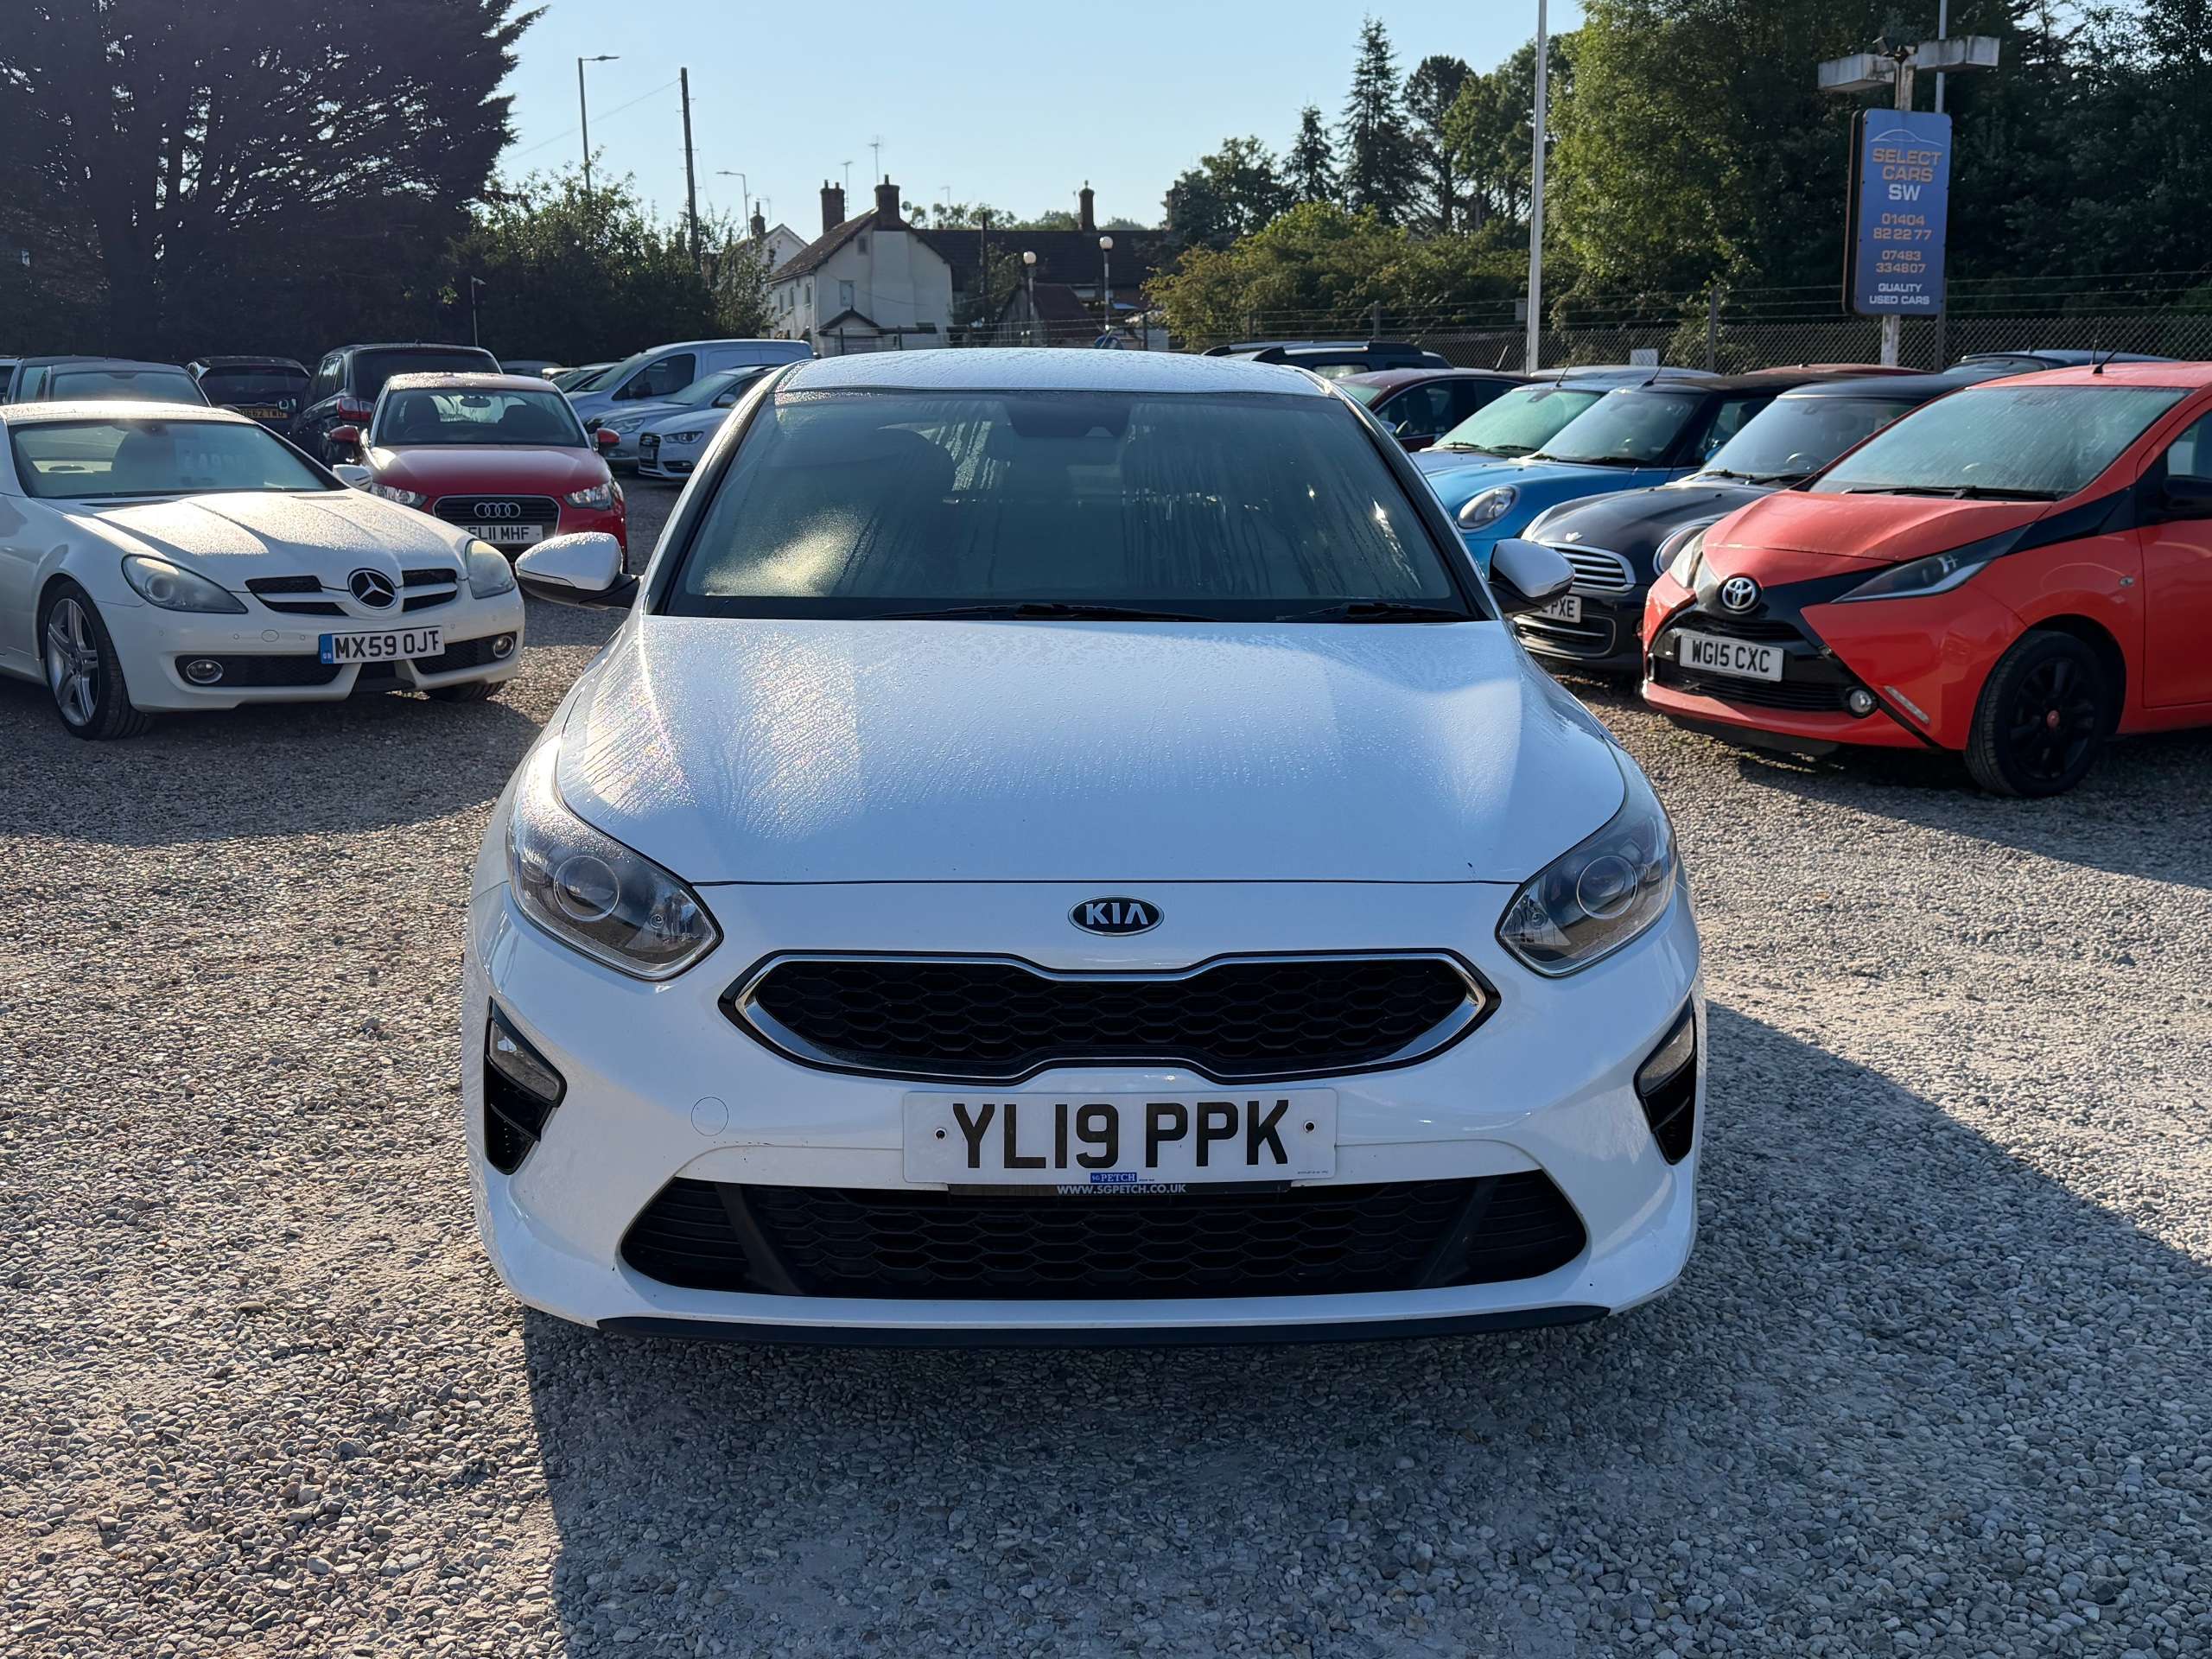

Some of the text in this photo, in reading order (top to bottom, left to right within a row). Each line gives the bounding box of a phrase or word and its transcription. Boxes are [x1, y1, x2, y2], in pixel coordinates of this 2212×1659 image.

[1872, 147, 1943, 167] SELECT
[1881, 165, 1934, 183] CARS
[1887, 183, 1922, 201] SW
[1881, 213, 1925, 226] 01404
[1881, 250, 1922, 261] 07483
[1875, 262, 1927, 273] 334807
[1878, 283, 1923, 293] QUALITY
[1869, 295, 1930, 305] USED CARS
[501, 526, 530, 540] MHF
[334, 635, 397, 659] MX59
[1692, 640, 1770, 673] WG15 CXC
[1085, 903, 1148, 925] KIA
[953, 1099, 1289, 1168] YL19 PPK
[1101, 1173, 1135, 1182] PETCH
[1057, 1184, 1186, 1195] WWW.SGPETCH.CO.UK
